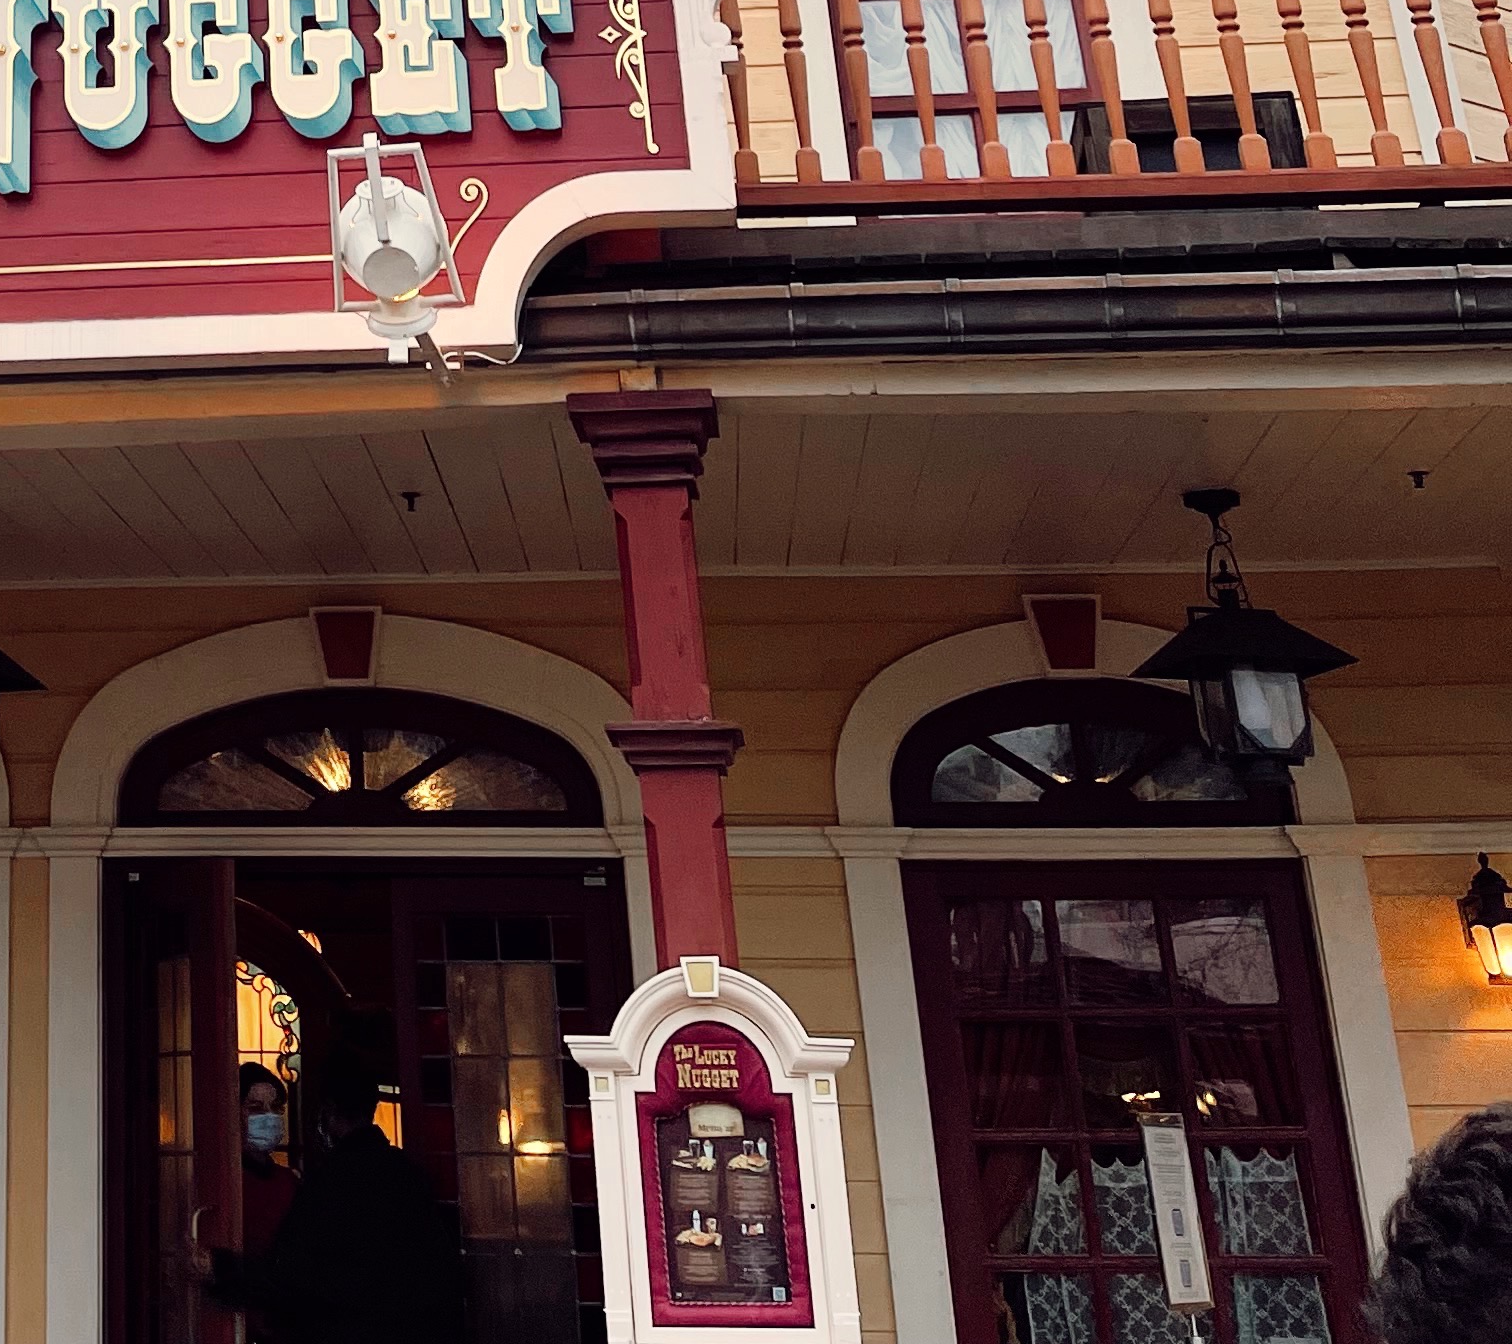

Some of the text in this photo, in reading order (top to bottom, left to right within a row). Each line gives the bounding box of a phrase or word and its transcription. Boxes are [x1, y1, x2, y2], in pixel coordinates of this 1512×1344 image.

[673, 1044, 736, 1065] The LUCKY
[676, 1063, 739, 1089] NUGGET
